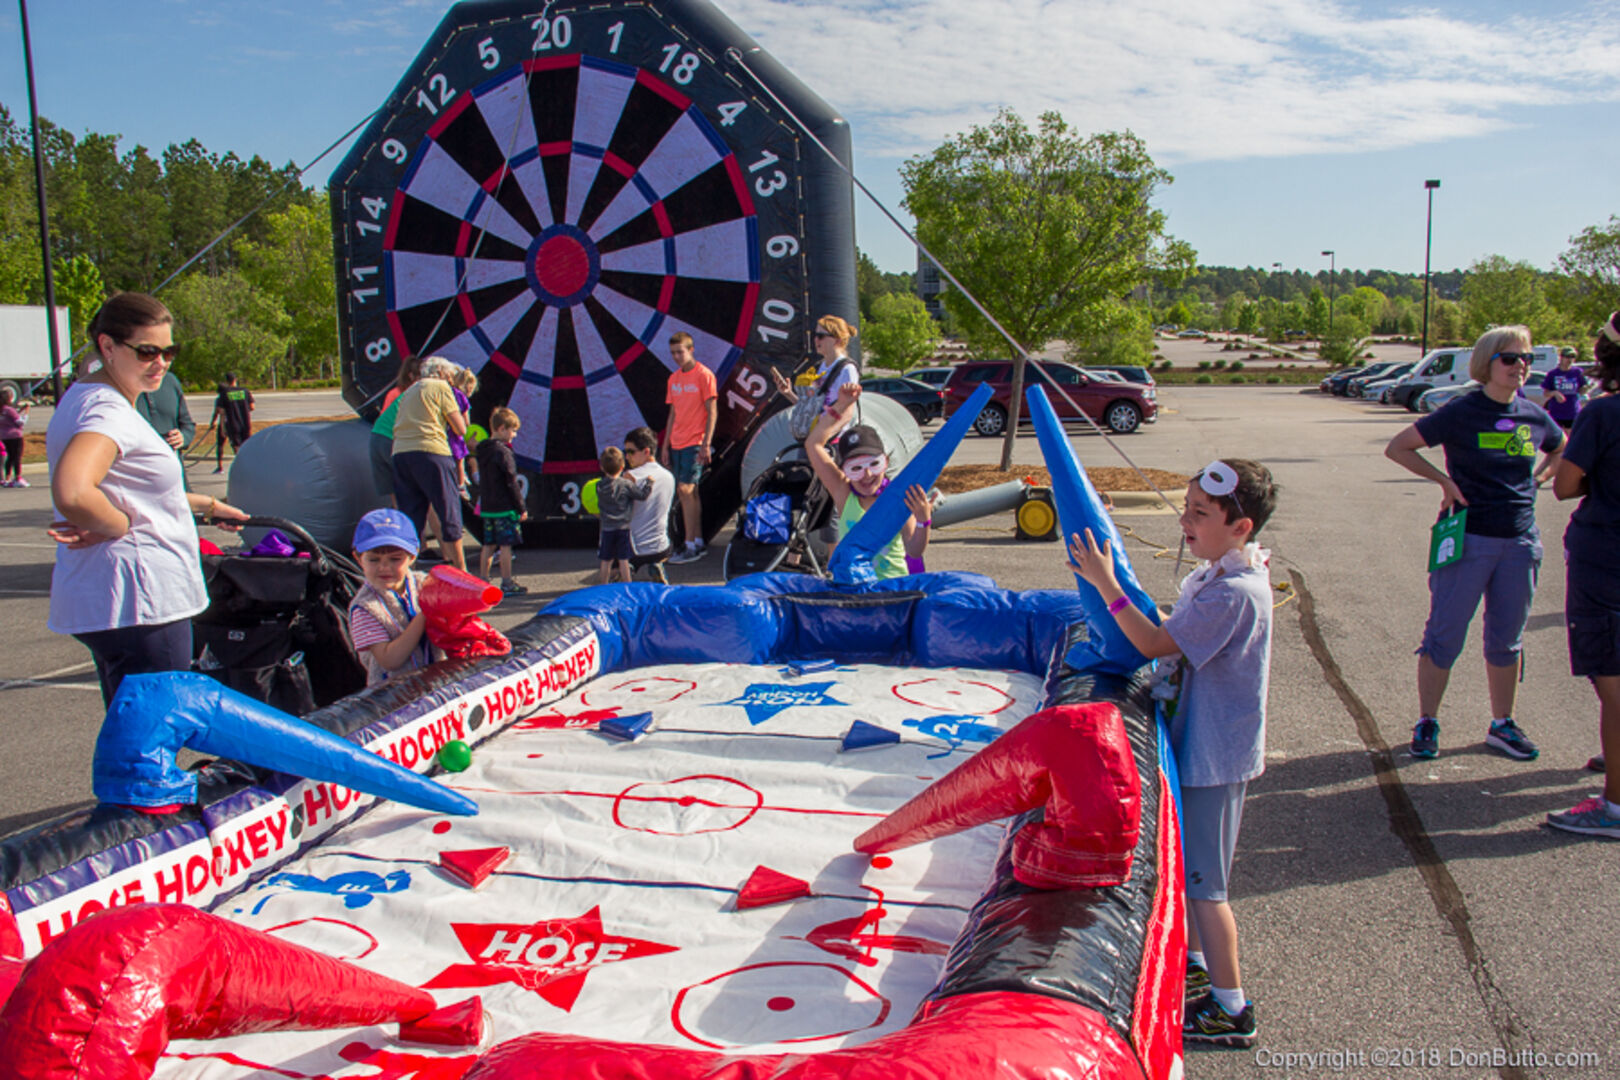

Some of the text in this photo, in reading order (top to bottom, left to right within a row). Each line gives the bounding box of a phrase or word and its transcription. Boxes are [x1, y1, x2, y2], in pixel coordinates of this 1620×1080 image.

[531, 15, 572, 51] 20
[607, 21, 624, 54] 1
[478, 37, 500, 70] 5
[658, 42, 700, 85] 18
[416, 73, 457, 115] 12
[717, 101, 748, 127] 4
[748, 149, 788, 198] 13
[356, 196, 387, 237] 14
[352, 265, 379, 304] 11
[757, 299, 796, 343] 10
[365, 337, 391, 363] 8
[726, 366, 768, 413] 15
[561, 481, 580, 514] 3
[484, 678, 536, 725] HOSE
[304, 782, 362, 827] HO
[479, 930, 628, 969] HOSE
